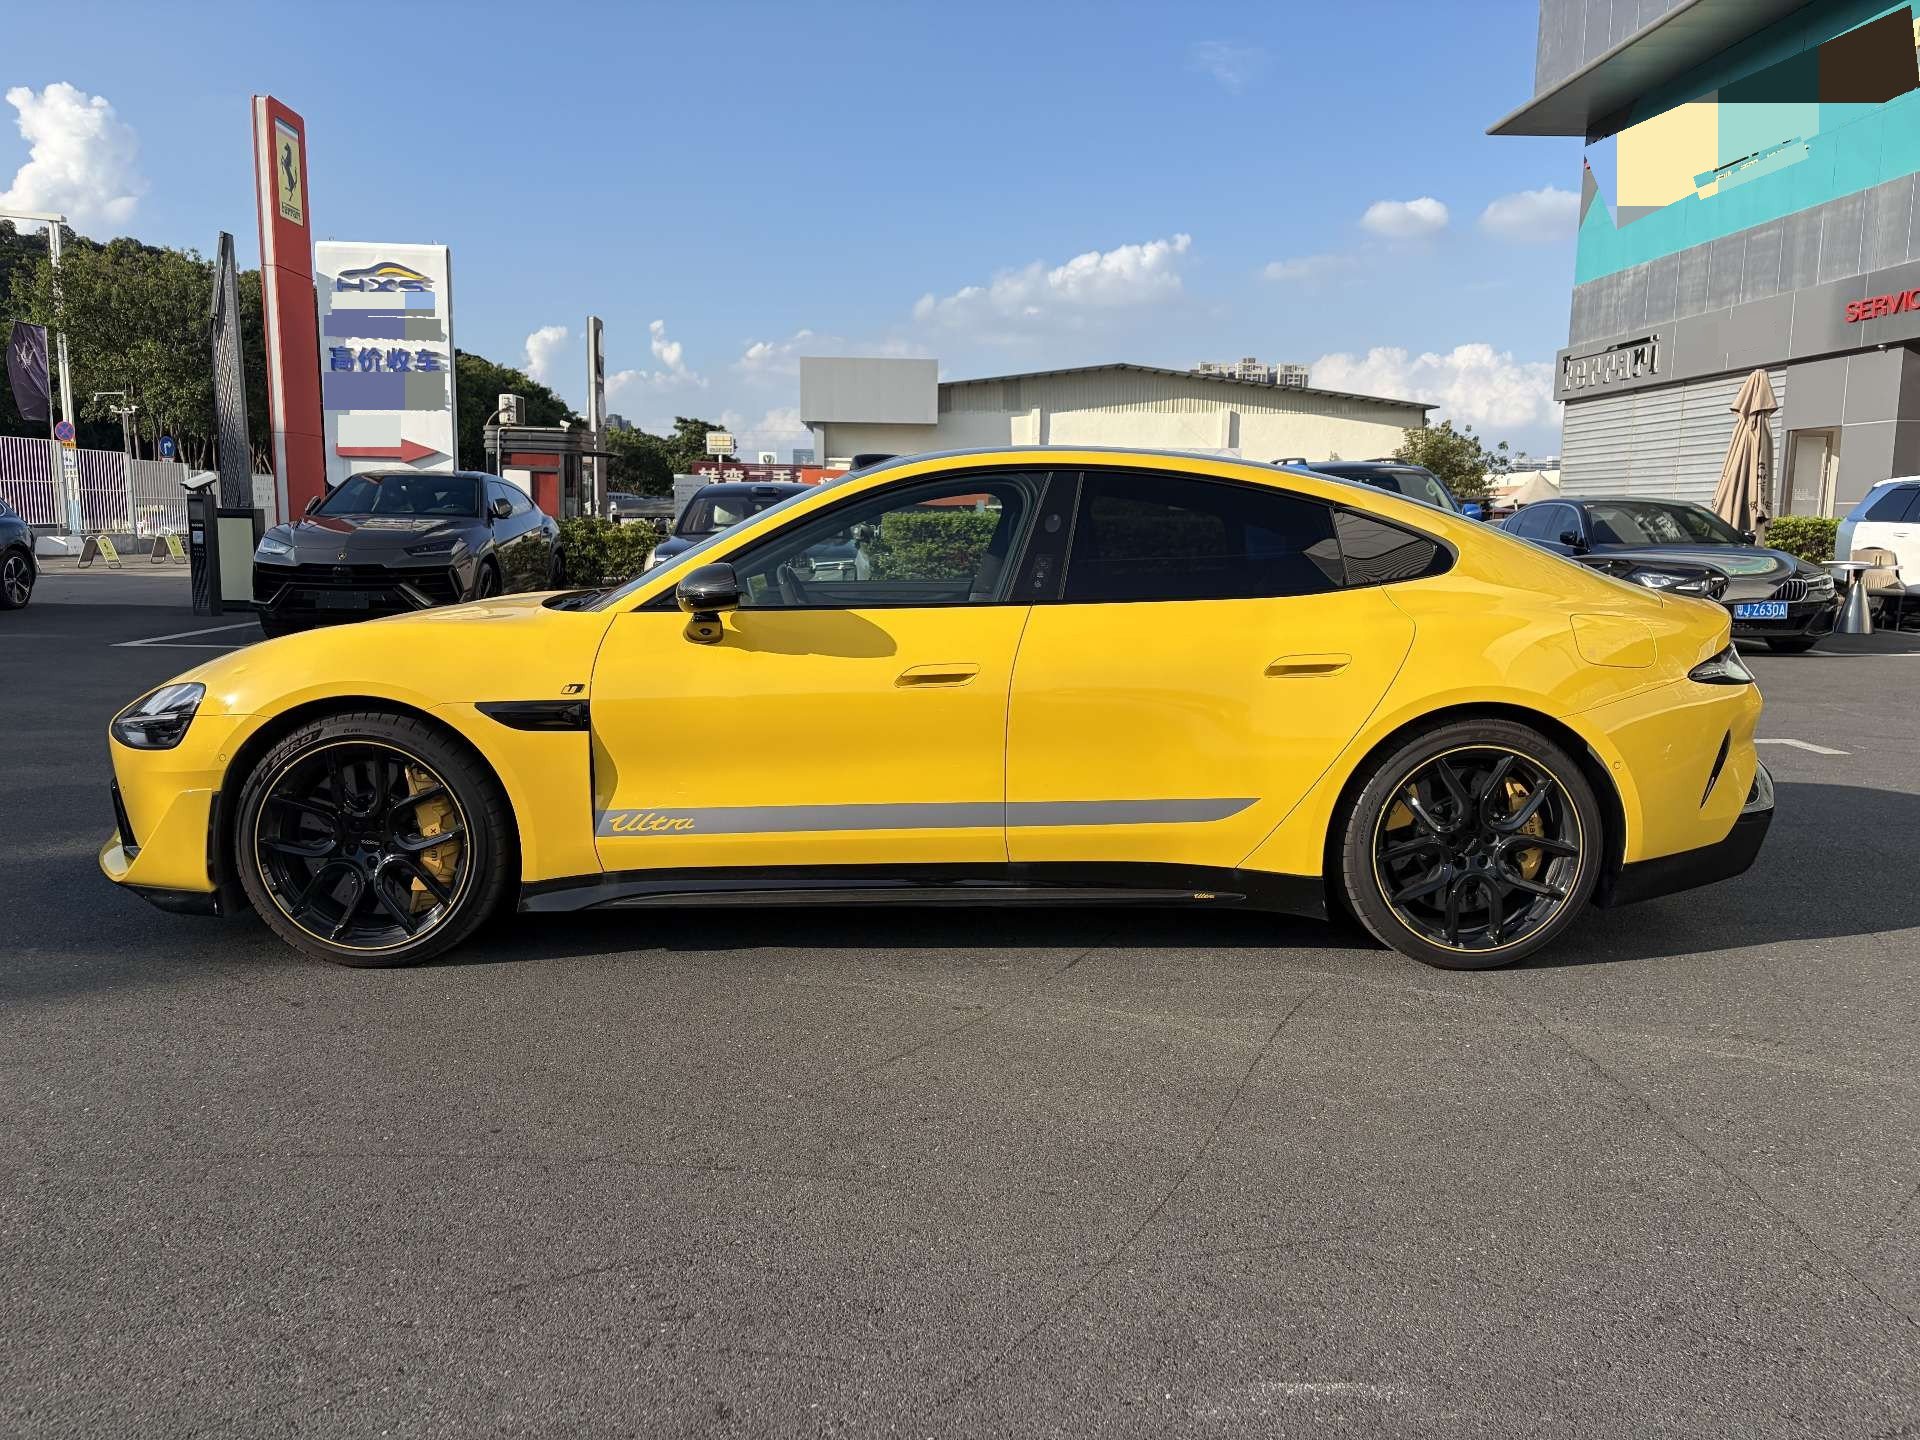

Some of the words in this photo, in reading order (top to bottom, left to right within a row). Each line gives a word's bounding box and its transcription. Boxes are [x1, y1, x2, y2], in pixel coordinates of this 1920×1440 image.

[281, 201, 302, 221] Ferrari
[328, 345, 442, 372] 高价收车
[1562, 334, 1660, 391] Ferrari
[608, 812, 696, 832] Ultra
